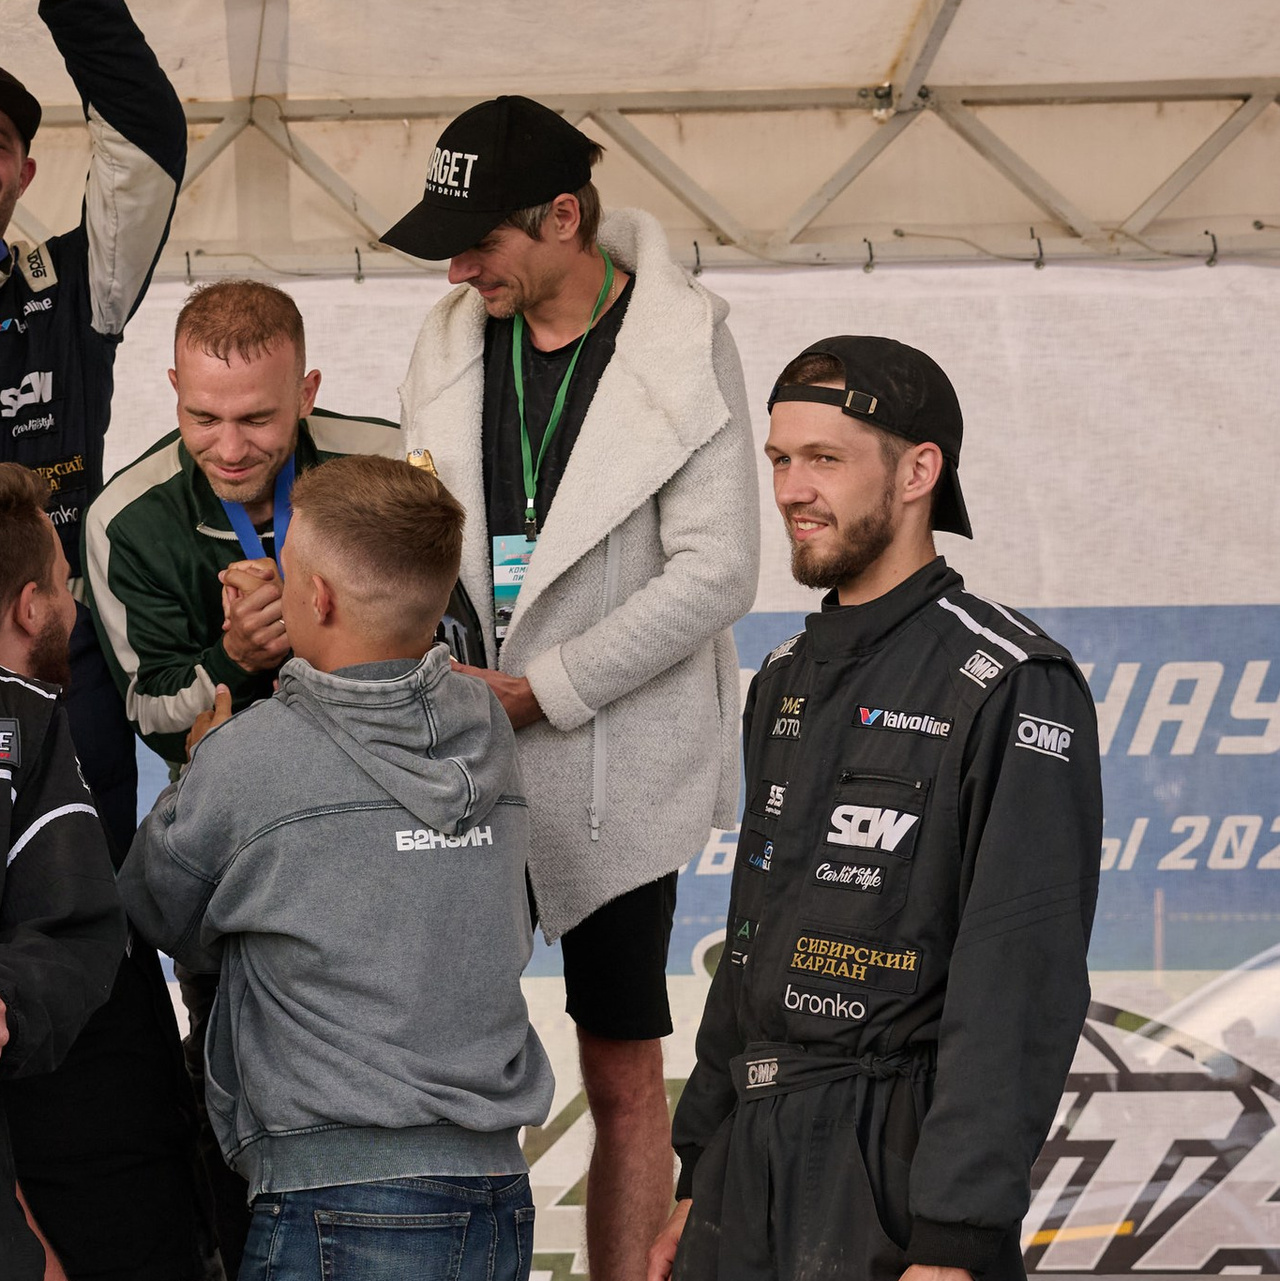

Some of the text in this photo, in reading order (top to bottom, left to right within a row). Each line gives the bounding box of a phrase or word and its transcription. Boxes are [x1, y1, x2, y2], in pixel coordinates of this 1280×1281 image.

[438, 186, 469, 199] DRINK
[508, 566, 528, 574] КОМ
[964, 652, 999, 681] OMP
[881, 709, 951, 737] Valvoline
[1017, 719, 1071, 754] OMP
[826, 804, 920, 852] SCW
[790, 952, 868, 981] КАРДАН
[796, 936, 917, 971] СИБИРСКИЙ
[784, 983, 866, 1019] bronko
[747, 1061, 779, 1085] OMP
